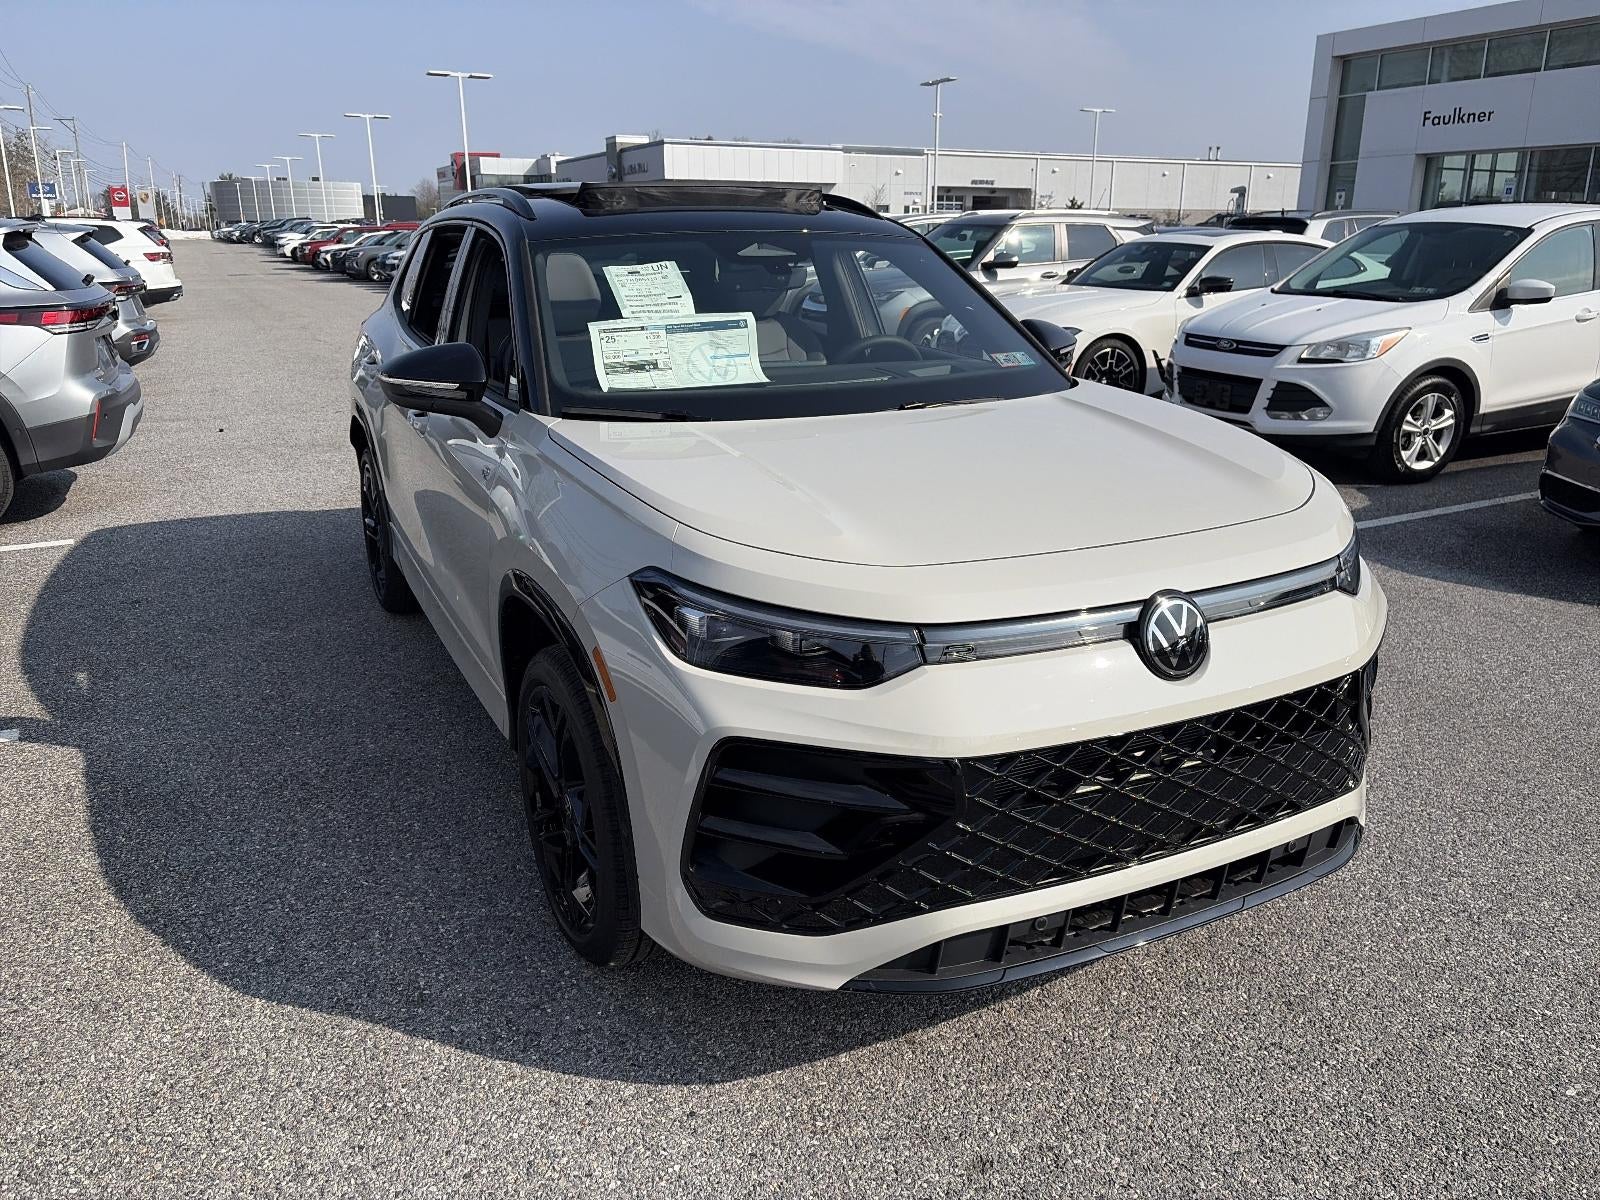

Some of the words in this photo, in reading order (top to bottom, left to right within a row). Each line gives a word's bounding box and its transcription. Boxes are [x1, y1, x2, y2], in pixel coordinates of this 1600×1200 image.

[1422, 107, 1494, 127] Faulkner
[650, 263, 669, 272] UN
[605, 335, 616, 344] 25
